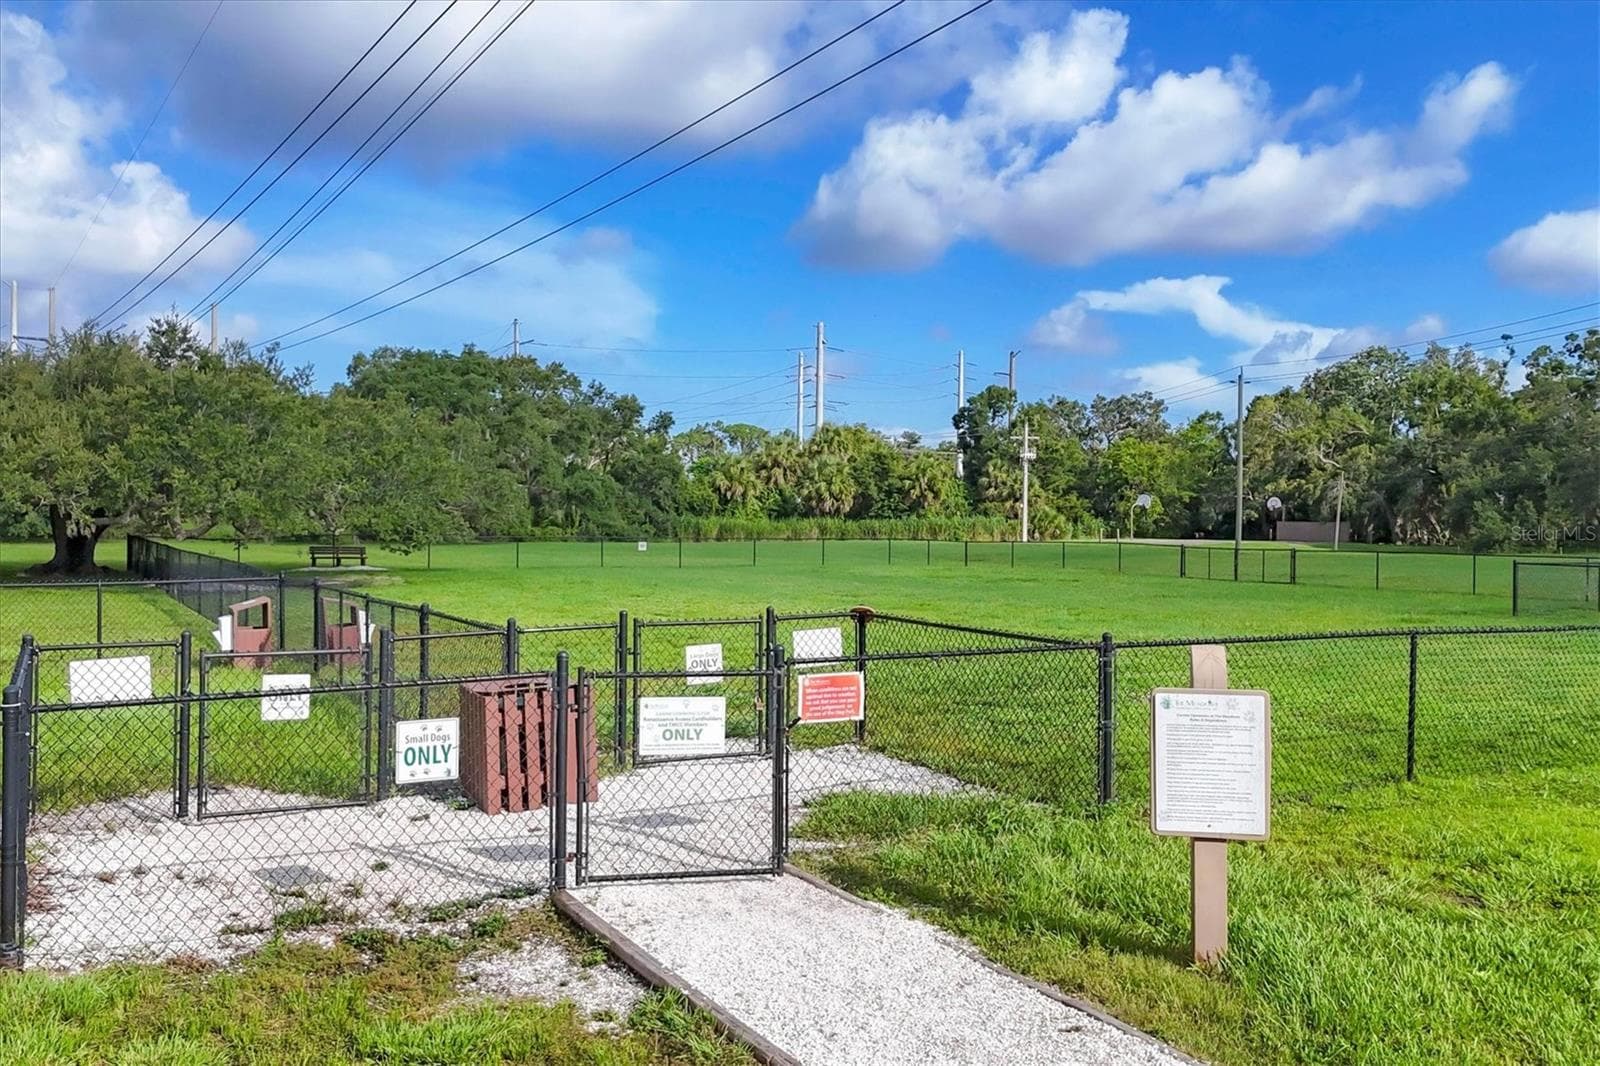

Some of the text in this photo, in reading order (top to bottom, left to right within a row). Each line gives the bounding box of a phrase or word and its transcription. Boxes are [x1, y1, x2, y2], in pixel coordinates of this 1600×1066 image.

[691, 658, 718, 669] ONLY
[404, 733, 451, 745] Small Dogs
[662, 728, 703, 741] ONLY
[403, 743, 452, 766] ONLY
